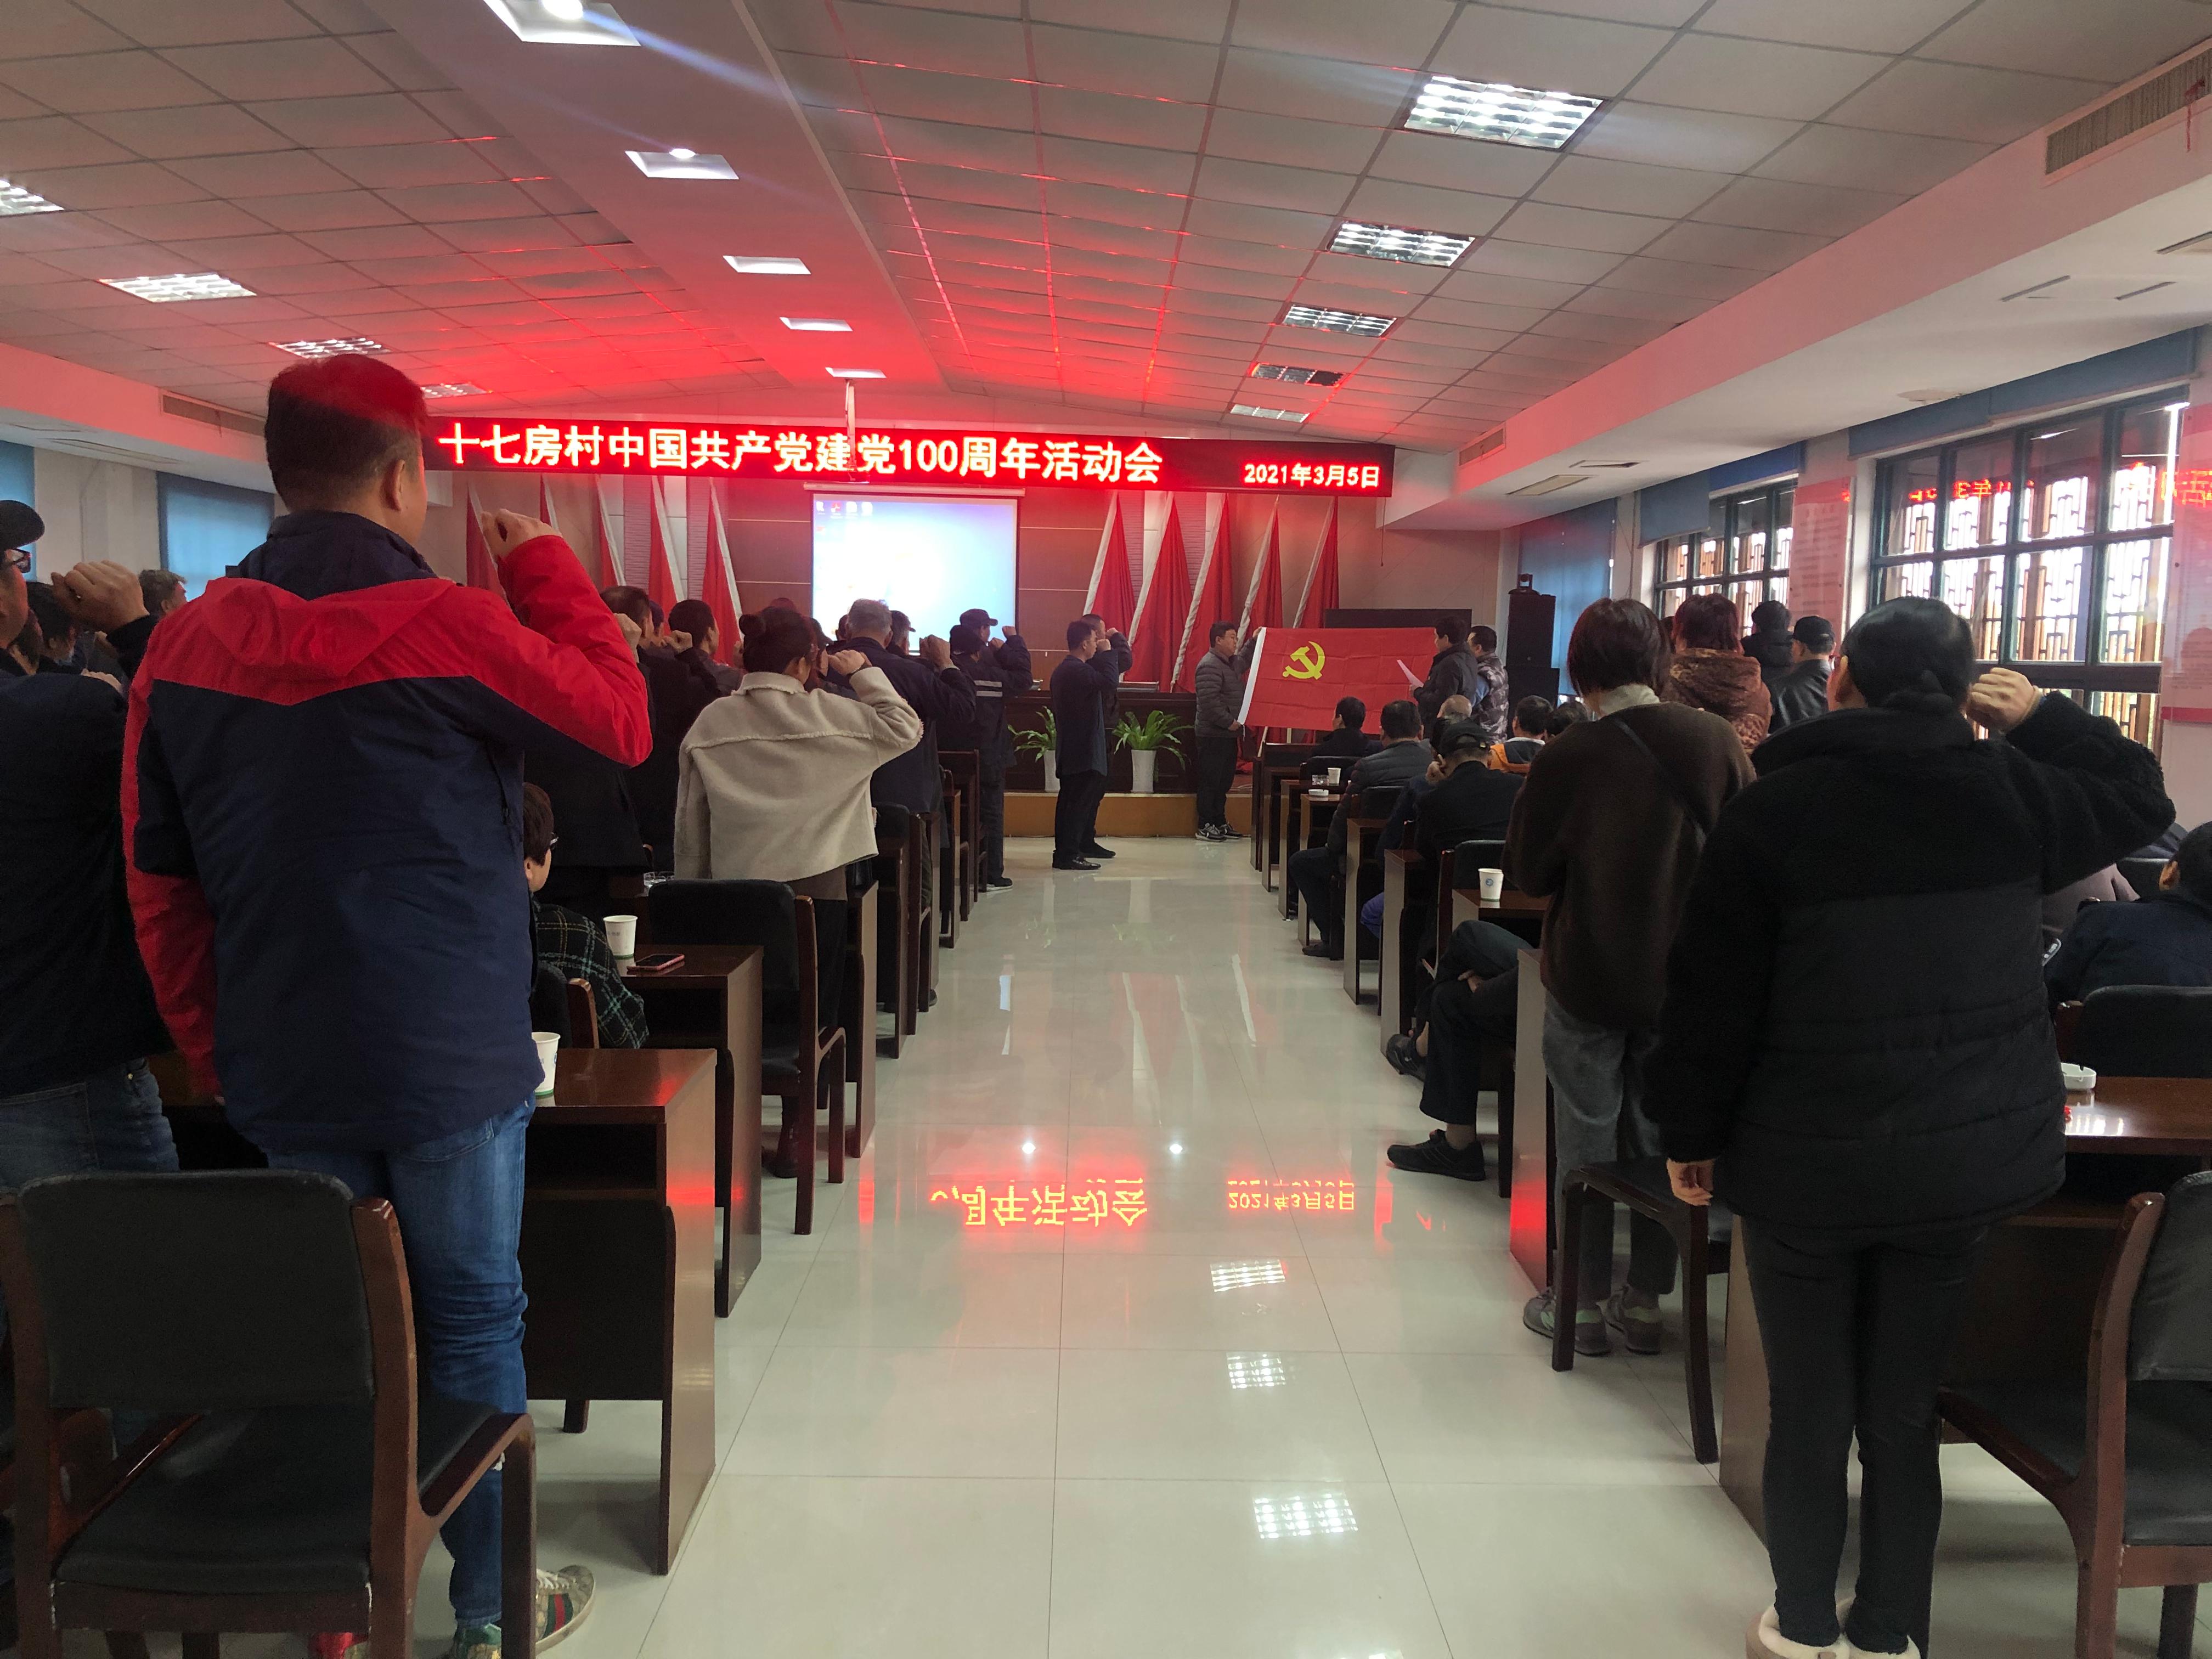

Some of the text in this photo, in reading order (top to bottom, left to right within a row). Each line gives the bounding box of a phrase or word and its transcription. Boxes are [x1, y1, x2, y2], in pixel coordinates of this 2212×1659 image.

[438, 422, 1163, 483] 十七房村中国共产党建党100周年活动会
[1244, 462, 1380, 489] 2021年3月5日
